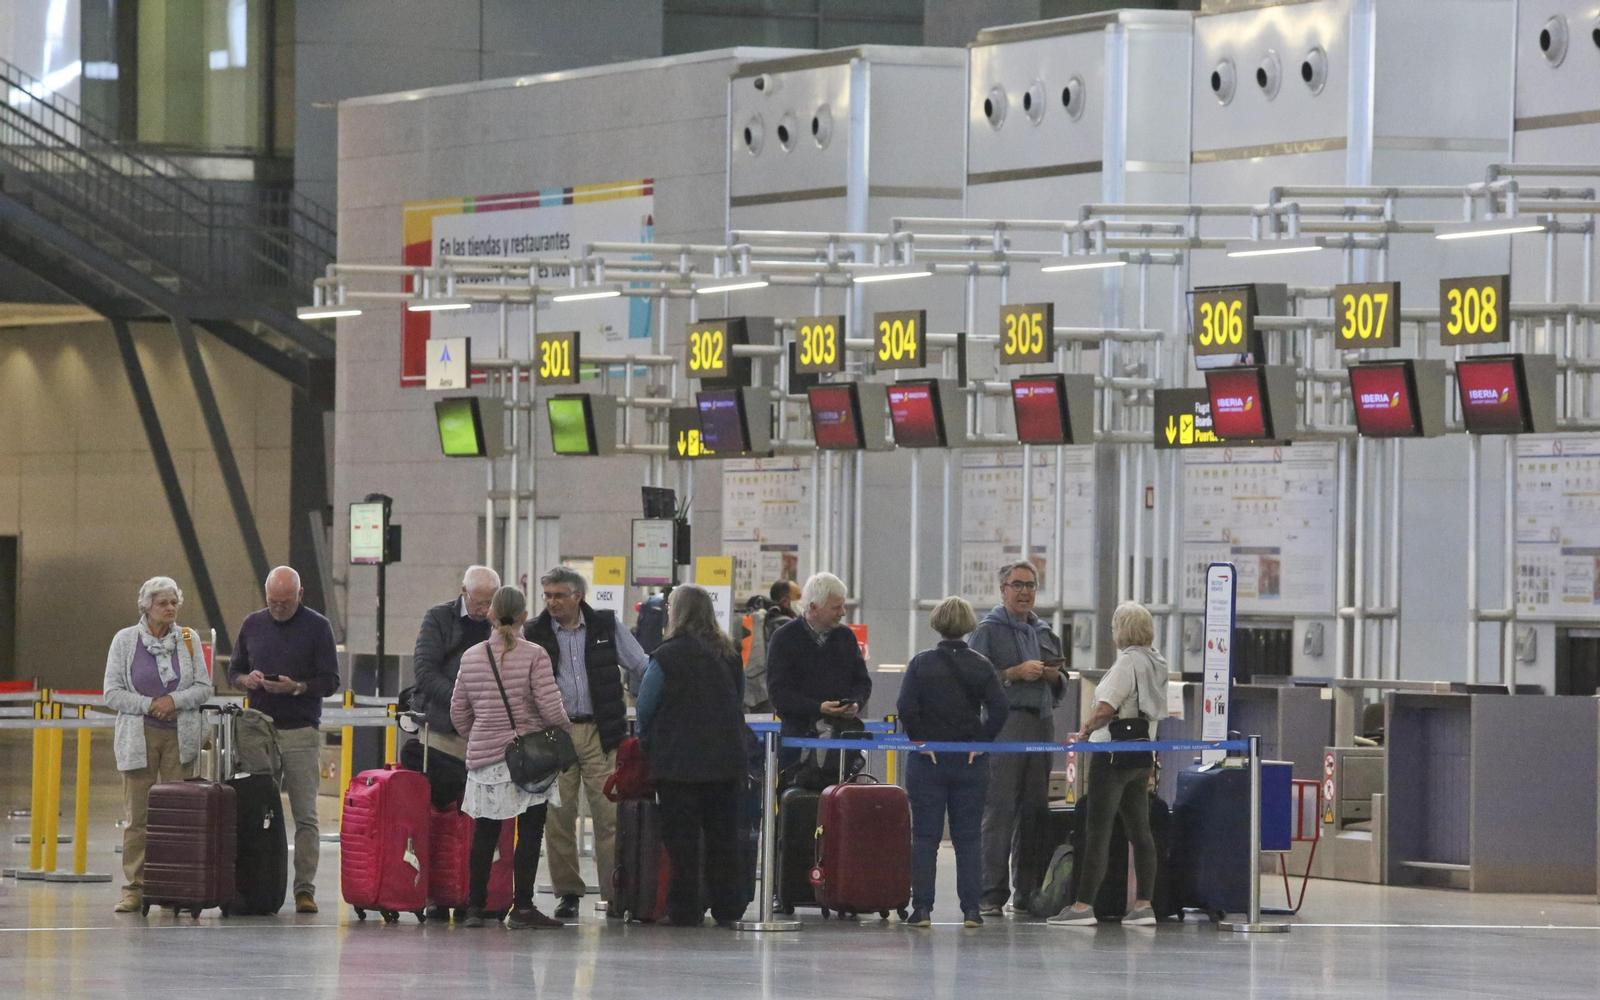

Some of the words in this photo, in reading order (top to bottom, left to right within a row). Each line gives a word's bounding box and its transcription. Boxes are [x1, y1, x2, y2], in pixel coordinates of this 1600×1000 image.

[440, 238, 451, 255] En
[453, 237, 465, 255] las
[468, 234, 501, 255] tiendas
[503, 237, 509, 257] y
[511, 231, 570, 253] restaurantes
[1199, 300, 1243, 346] 306
[1341, 293, 1388, 339] 307
[1447, 286, 1497, 335] 308
[689, 330, 723, 370] 302
[800, 324, 836, 365] 303
[878, 319, 917, 361] 304
[1004, 312, 1043, 355] 305
[540, 339, 570, 378] 301
[1217, 398, 1244, 407] IBERIA
[1361, 393, 1390, 403] IBERIA
[1469, 389, 1499, 399] IBERIA
[597, 591, 614, 601] CHECK
